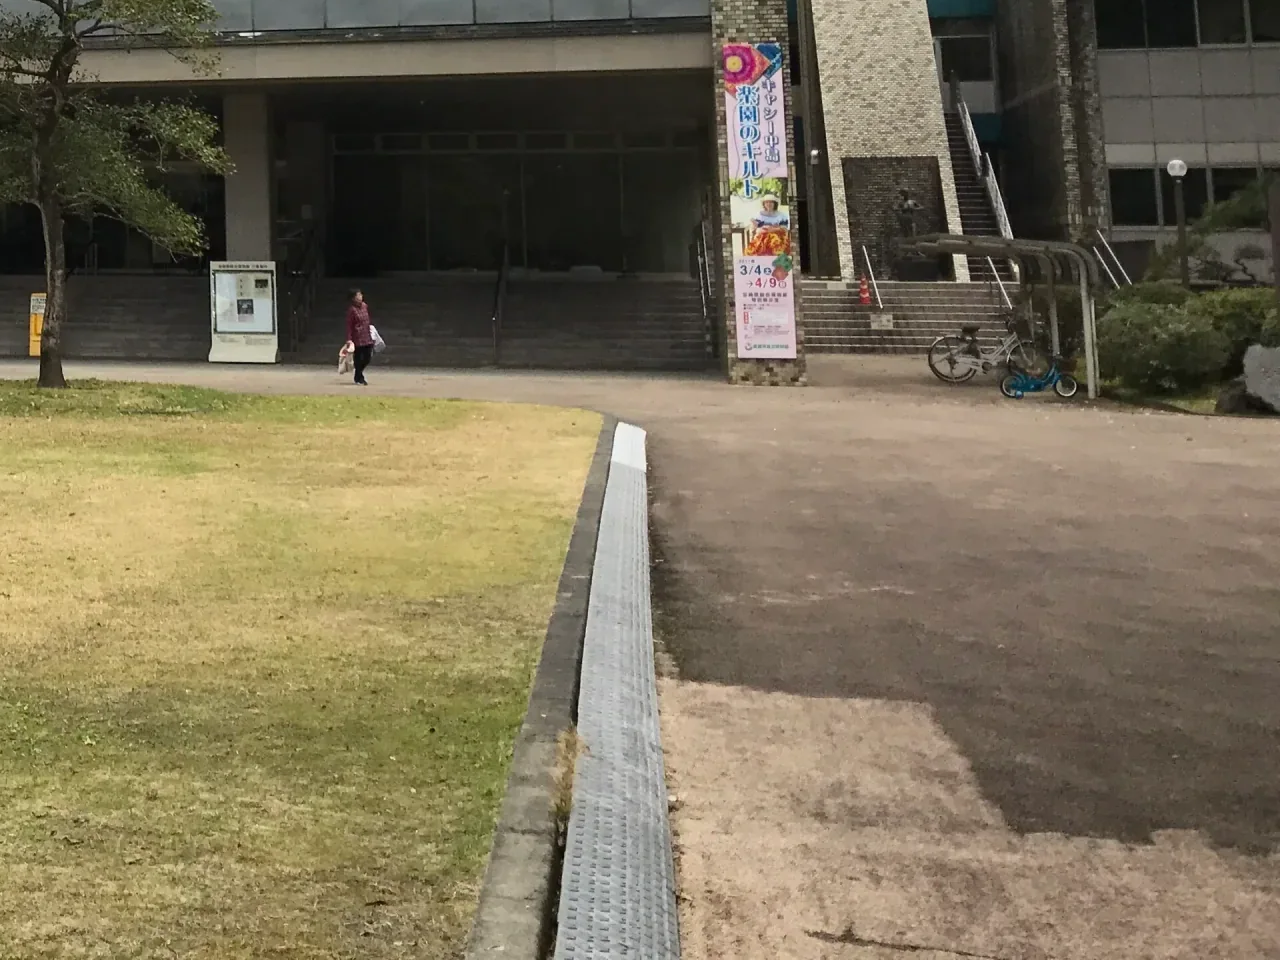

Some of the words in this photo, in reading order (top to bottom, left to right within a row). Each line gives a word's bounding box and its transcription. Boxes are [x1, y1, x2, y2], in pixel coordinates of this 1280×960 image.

[737, 85, 763, 198] 楽園のキルト
[762, 79, 780, 162] キャシー中島
